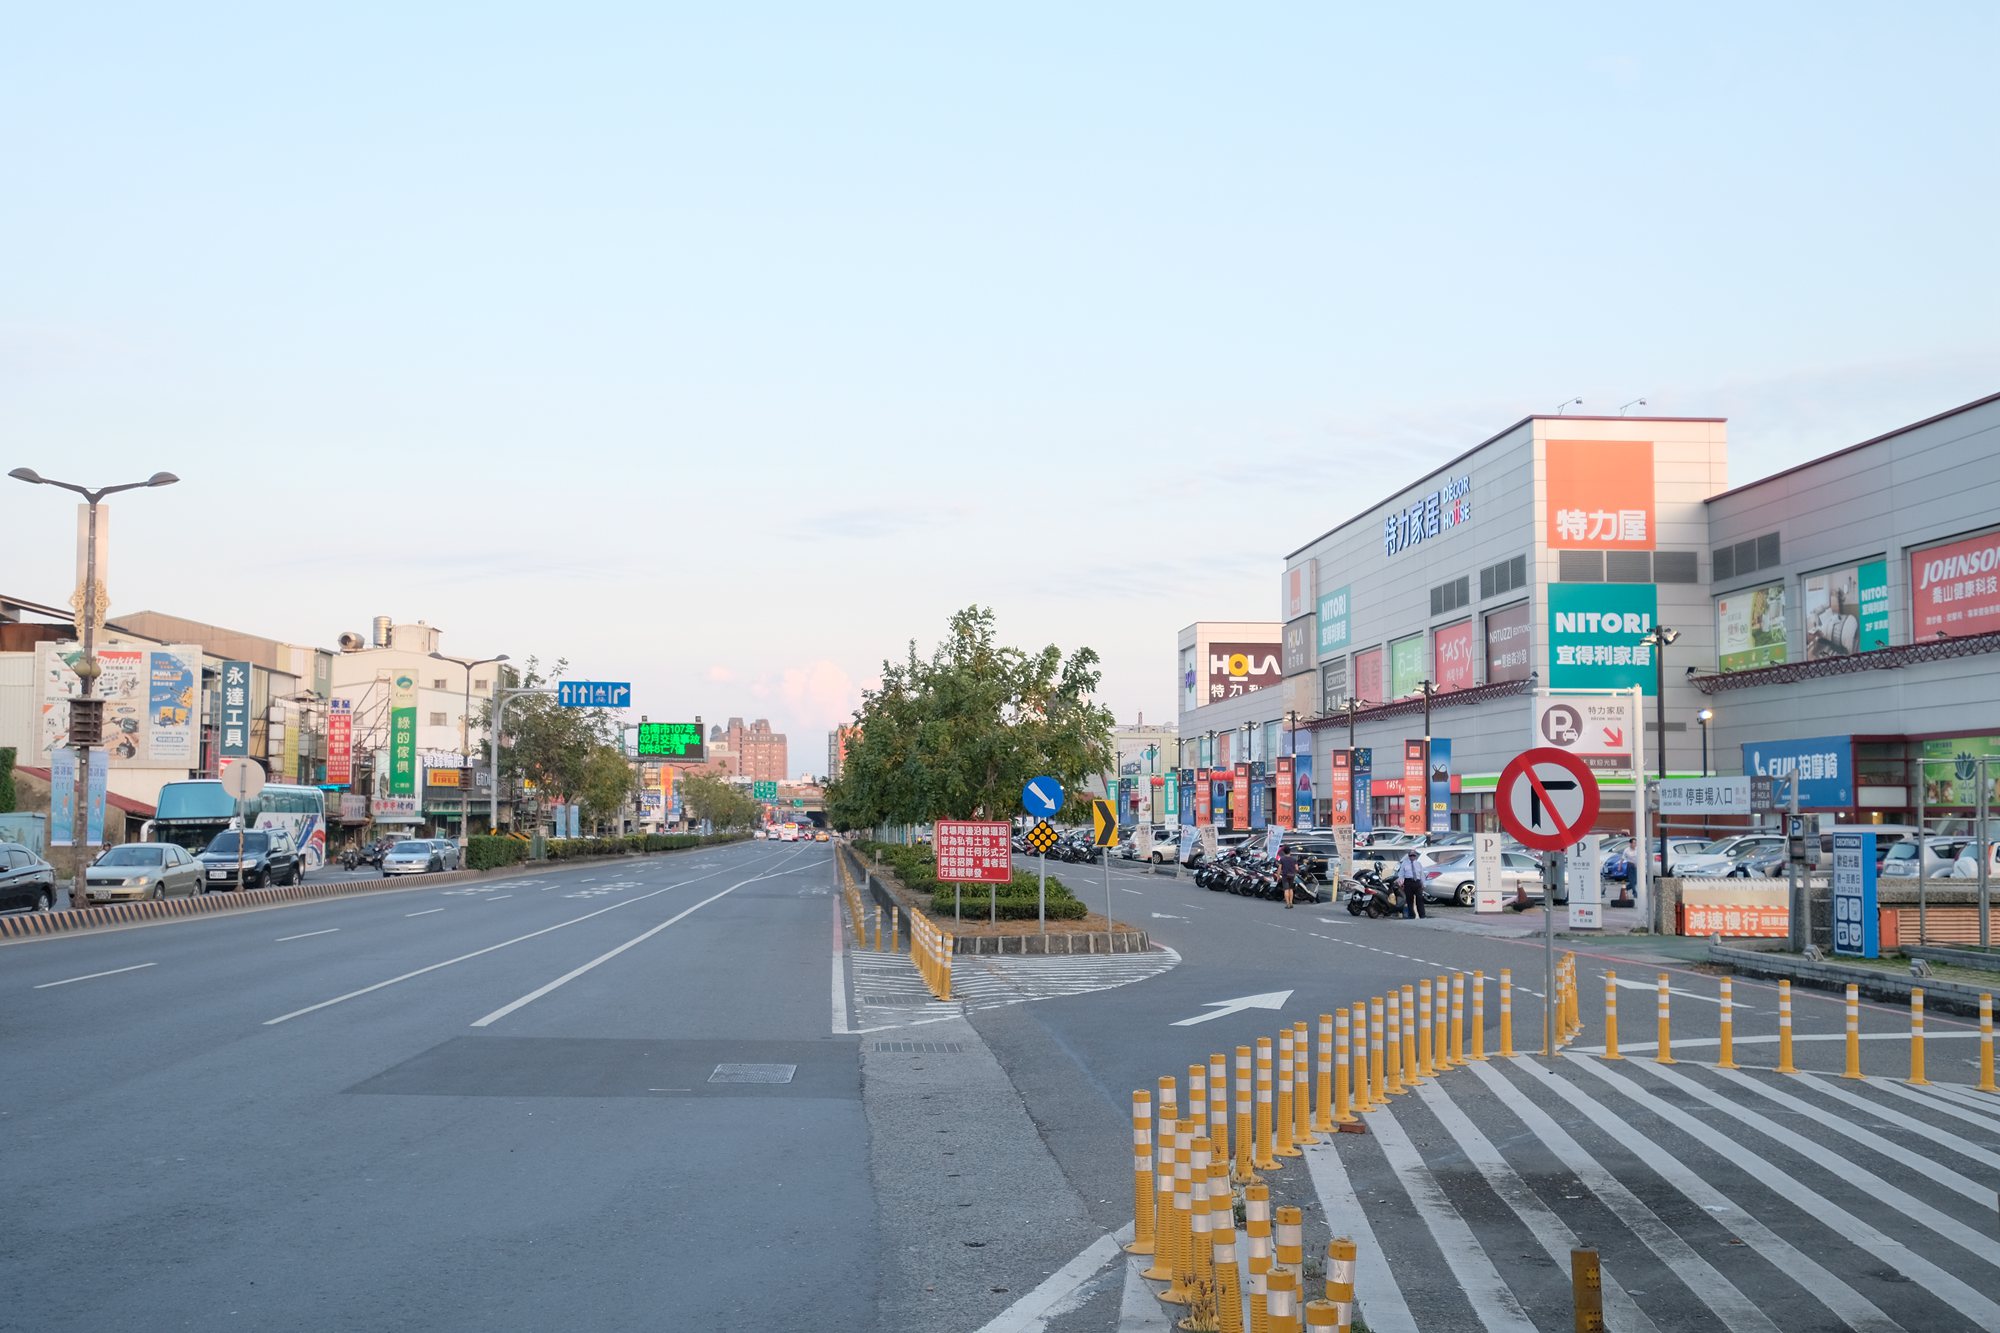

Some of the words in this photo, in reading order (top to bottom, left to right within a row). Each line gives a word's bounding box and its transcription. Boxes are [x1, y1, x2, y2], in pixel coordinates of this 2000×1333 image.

[1384, 491, 1441, 556] 特力家居
[1556, 509, 1648, 541] 特力屋
[1321, 594, 1346, 623] NITORI
[1555, 612, 1651, 634] NITORI
[1287, 627, 1304, 649] HOLA
[1210, 653, 1282, 677] HOLA
[1556, 645, 1651, 666] 宜得利家居
[1210, 684, 1263, 698] 特力
[224, 666, 245, 748] 永達工具
[1588, 706, 1625, 715] 特力家居
[640, 723, 696, 734] 台南市107年
[640, 733, 700, 745] 02月交通事故
[1798, 752, 1838, 780] 按摩椅
[1661, 788, 1684, 799] 特力家居
[1686, 787, 1733, 806] 停車場入口
[1409, 814, 1421, 824] 99
[1791, 820, 1801, 835] P
[1483, 839, 1494, 852] P
[1576, 841, 1587, 857] P
[1689, 911, 1759, 930] 減速慢行
